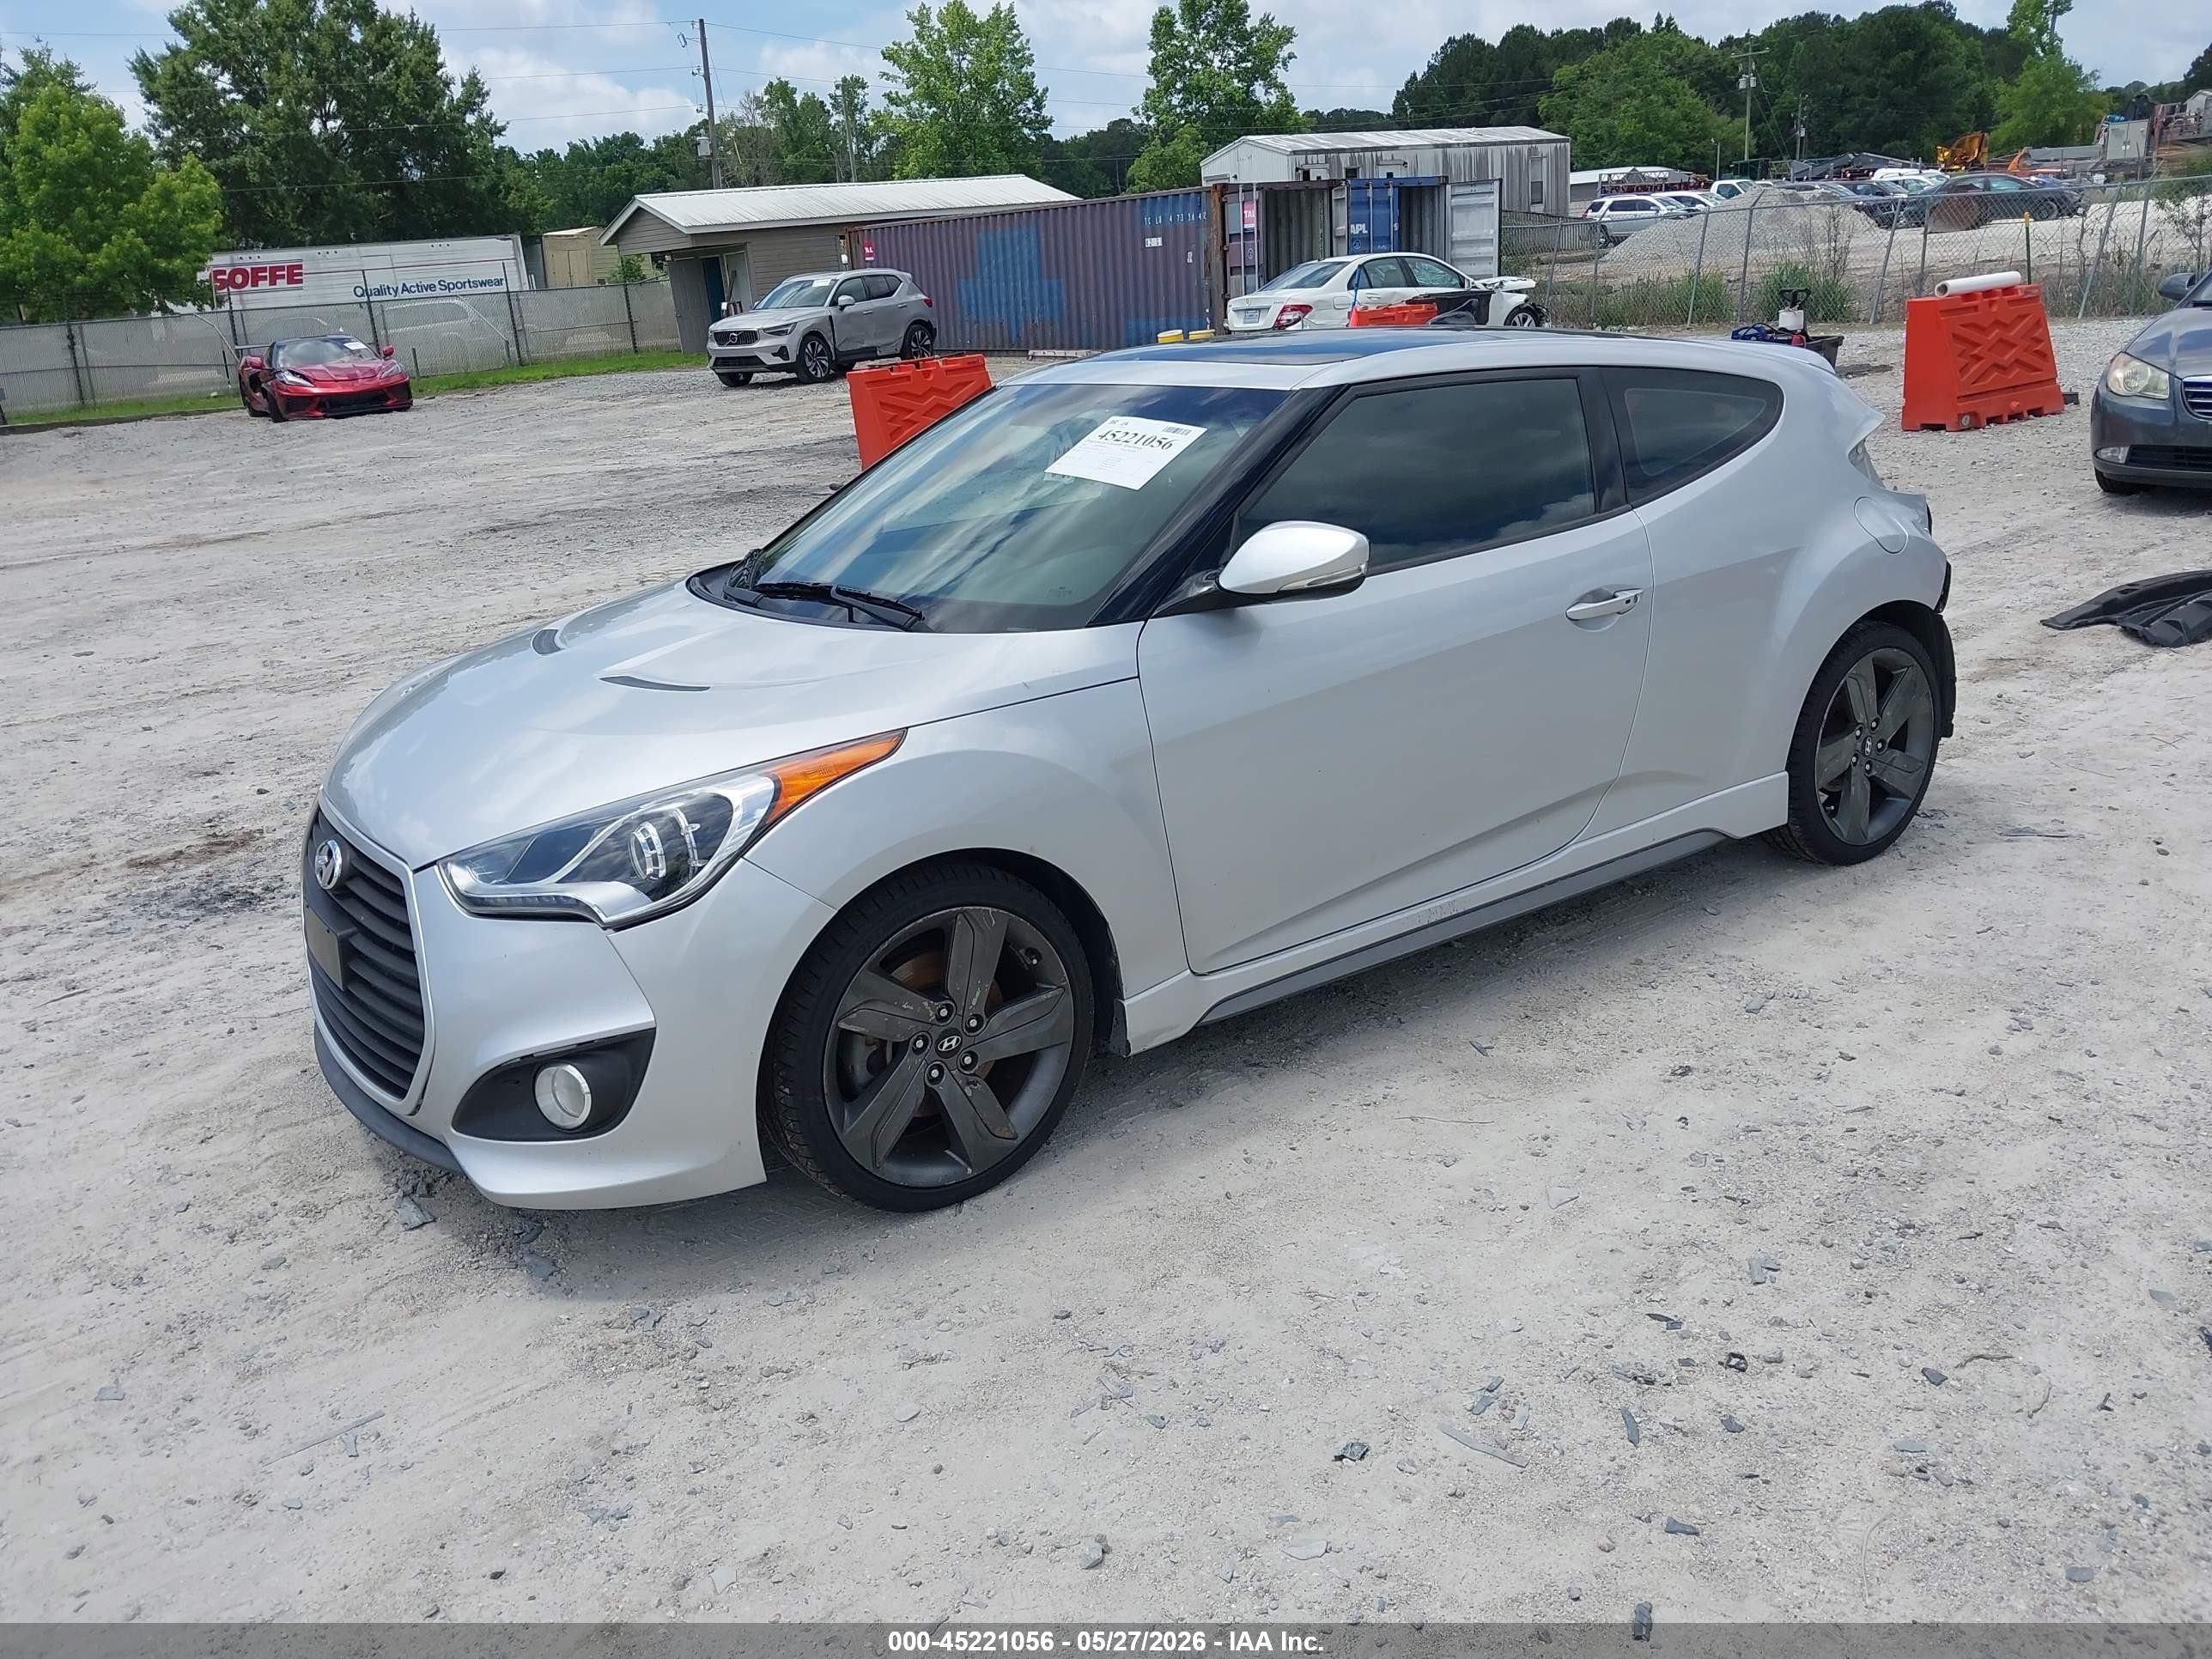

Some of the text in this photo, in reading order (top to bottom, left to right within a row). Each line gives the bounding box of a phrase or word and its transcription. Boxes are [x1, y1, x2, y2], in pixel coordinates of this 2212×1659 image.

[1350, 223, 1368, 234] APL
[210, 264, 303, 291] SOFFE
[354, 277, 504, 298] Quality Active Sportswear
[1098, 429, 1179, 450] 45221056
